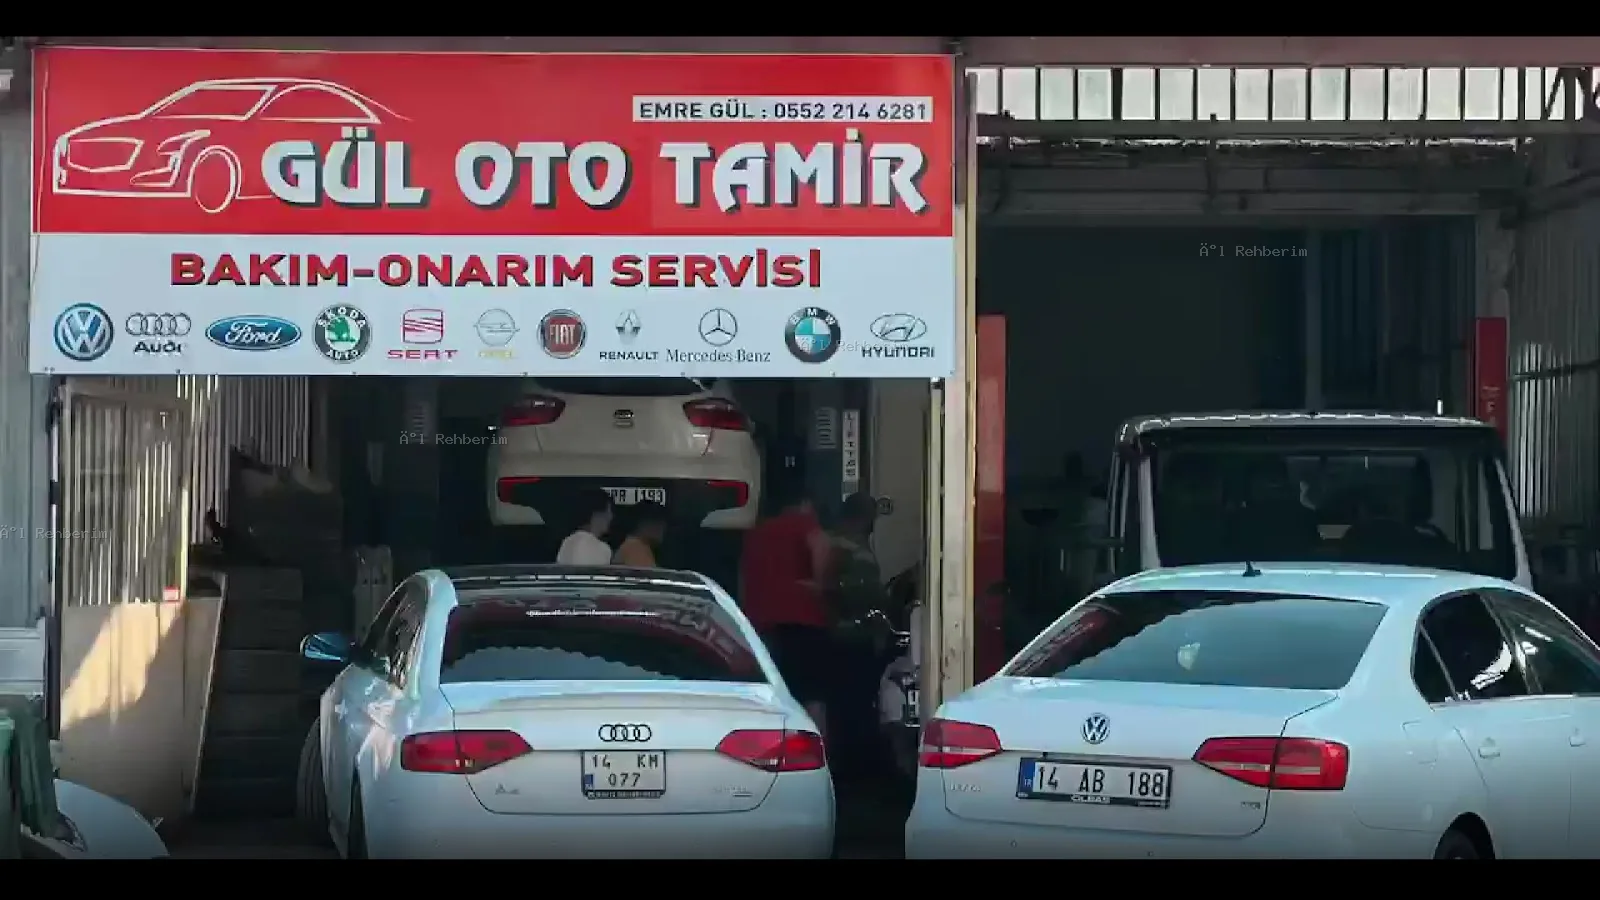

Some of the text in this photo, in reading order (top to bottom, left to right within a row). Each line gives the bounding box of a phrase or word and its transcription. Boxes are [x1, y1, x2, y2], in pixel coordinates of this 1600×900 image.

[640, 102, 702, 119] EMRE
[709, 98, 753, 119] GÜL
[774, 102, 825, 119] 0552
[832, 103, 870, 119] 214
[877, 103, 926, 120] 6281
[261, 126, 928, 213] GÜL OTO TAMİR
[170, 253, 594, 287] BAKIM-ONARIM
[225, 321, 282, 344] Ford
[550, 323, 576, 346] FIAT
[327, 349, 361, 361] AUTO
[387, 349, 459, 360] SEAT
[599, 351, 659, 361] RENAULT
[592, 754, 611, 768] 14
[608, 772, 641, 787] 077
[1038, 766, 1164, 797] 14 AB 188
